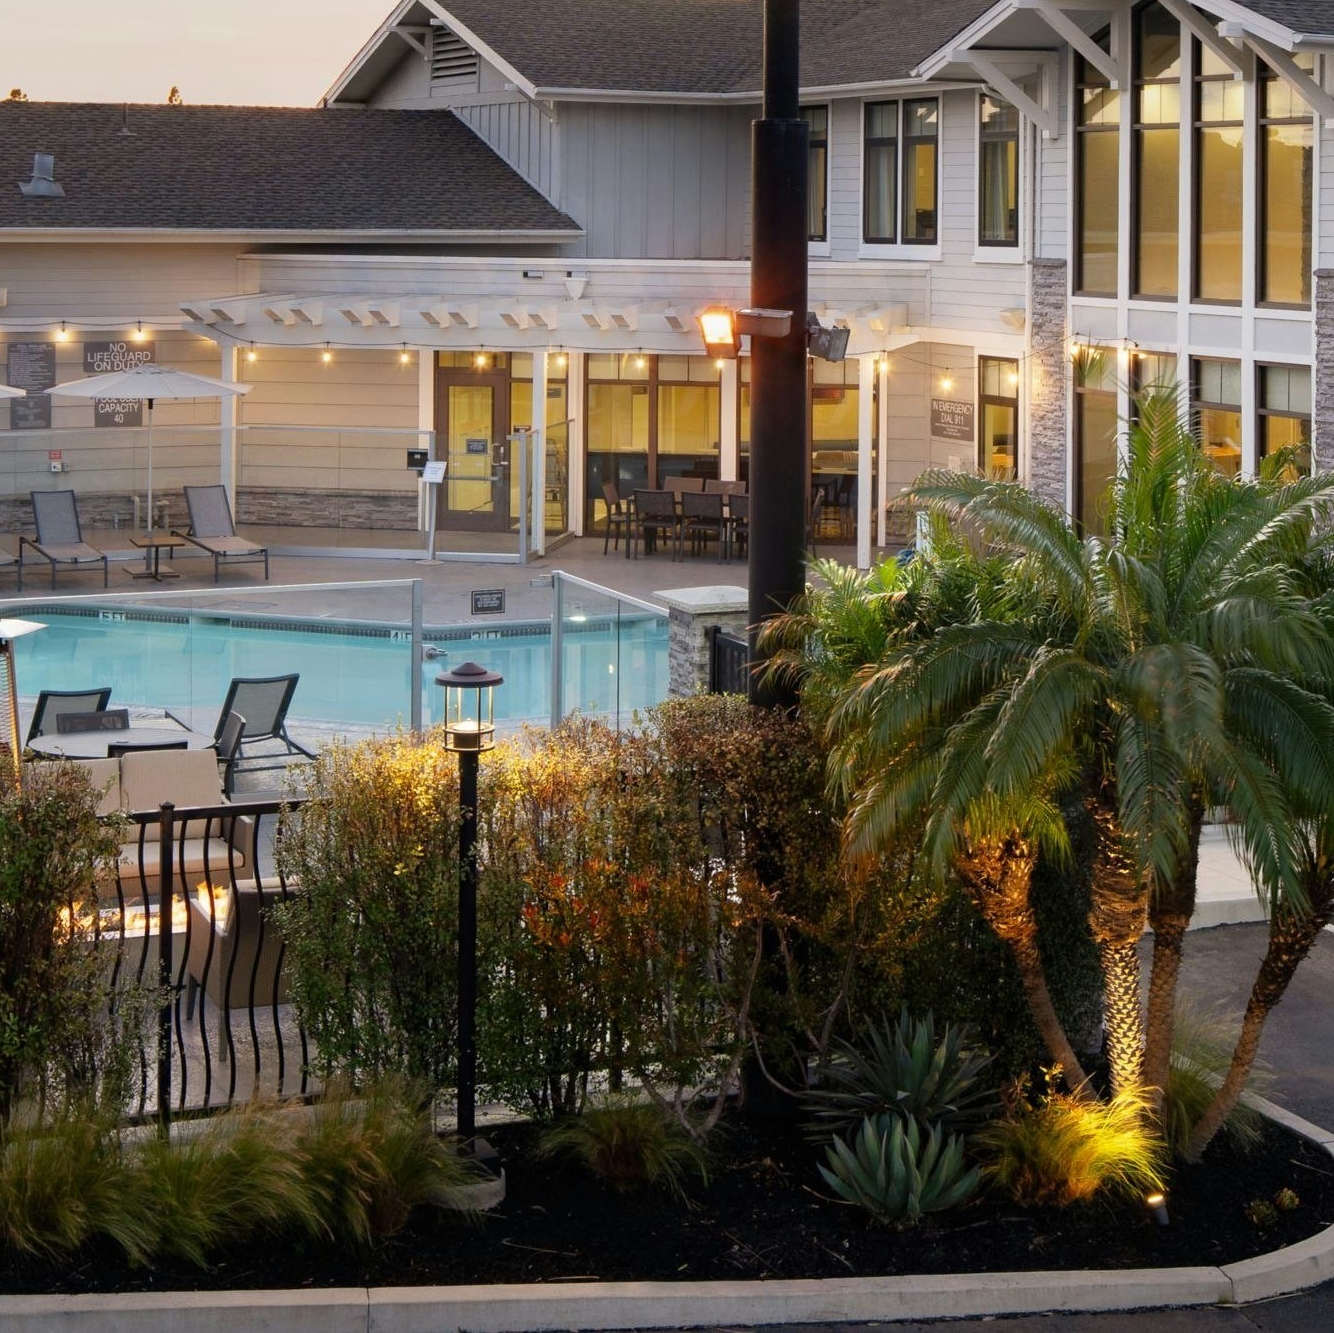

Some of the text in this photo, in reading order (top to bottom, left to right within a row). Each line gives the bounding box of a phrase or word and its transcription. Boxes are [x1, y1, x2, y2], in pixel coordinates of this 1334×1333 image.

[109, 343, 126, 352] NO
[87, 351, 151, 362] LIFEGUARD
[94, 361, 111, 371] ON
[98, 402, 139, 413] CAPACITY
[939, 401, 973, 415] EMERGENCY
[114, 413, 124, 423] 40
[940, 412, 964, 425] DIAL 911
